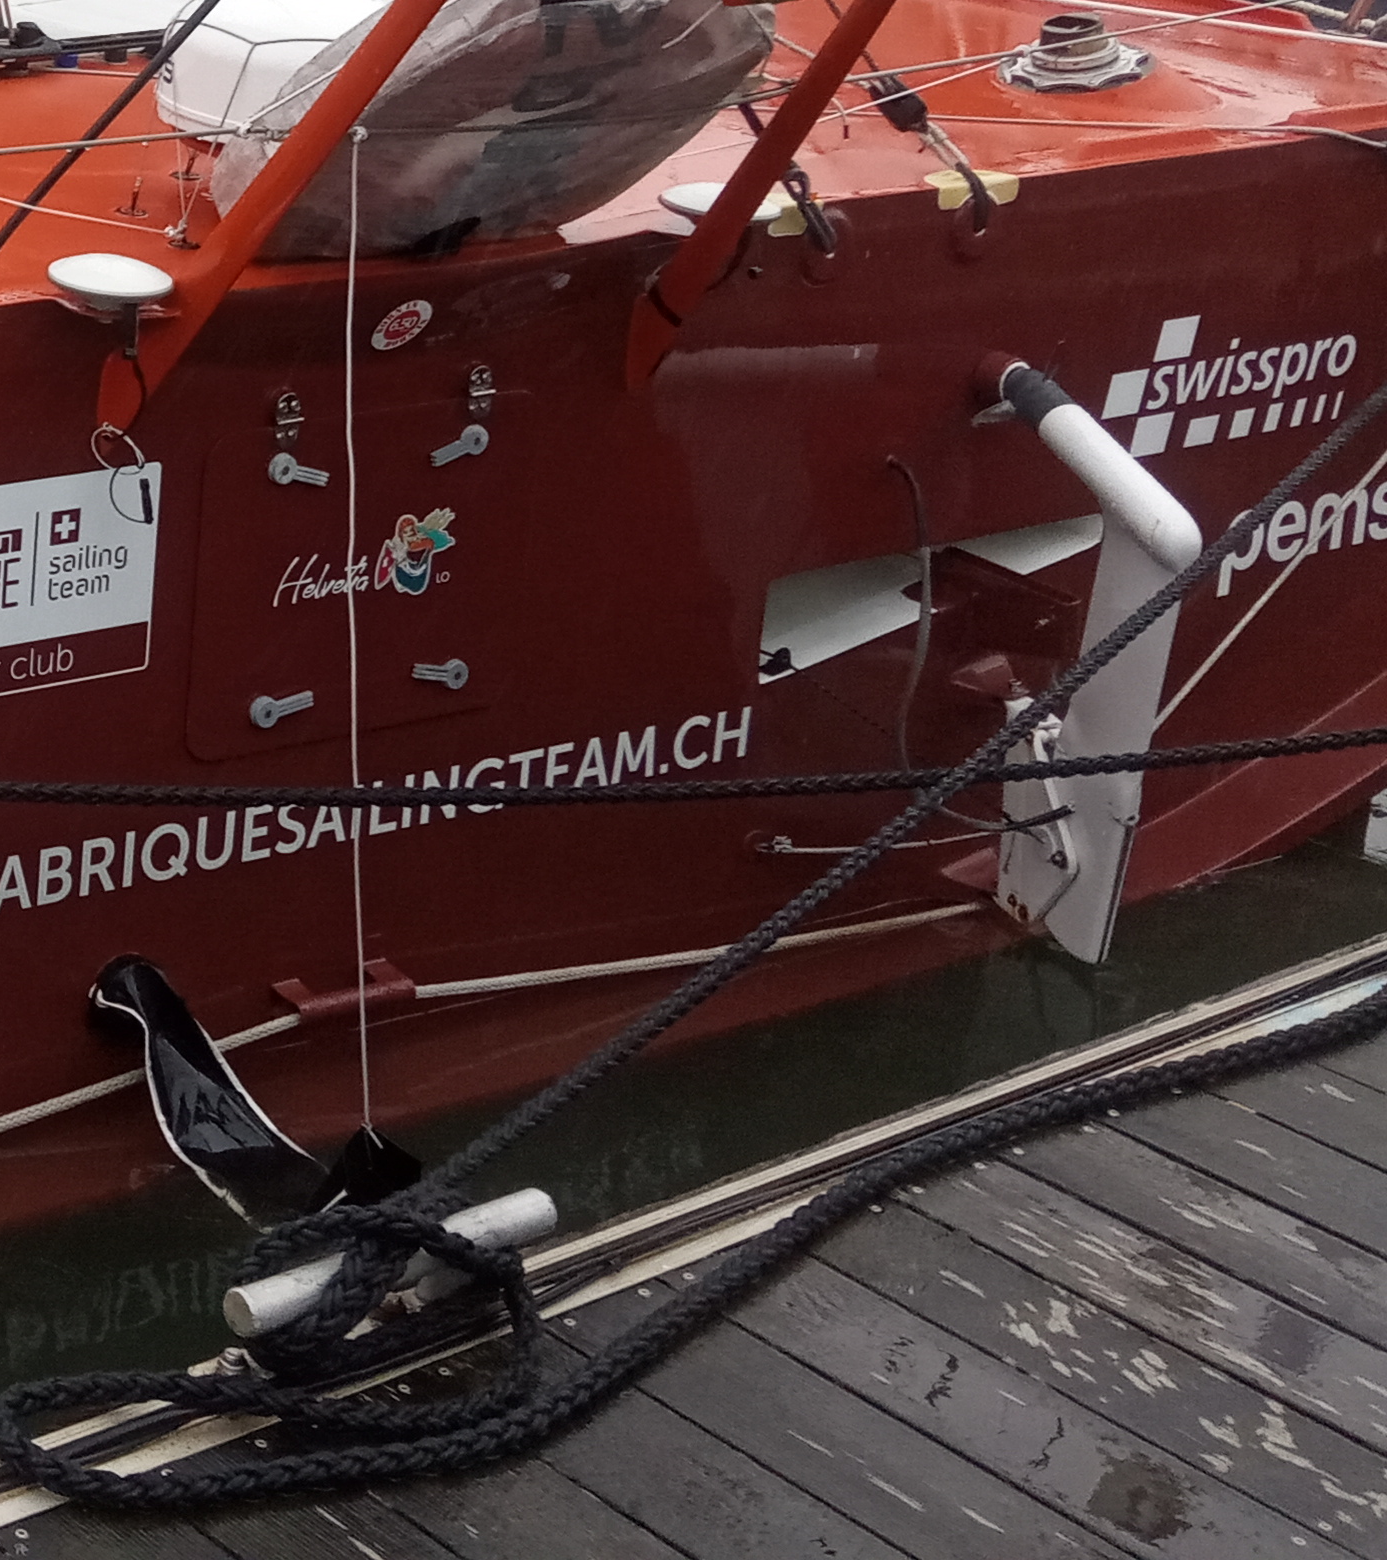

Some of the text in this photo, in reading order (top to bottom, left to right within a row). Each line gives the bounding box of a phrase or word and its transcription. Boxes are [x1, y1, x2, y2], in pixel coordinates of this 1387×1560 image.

[1146, 334, 1357, 410] swisspro
[49, 545, 128, 575] sailing
[48, 575, 111, 602] team
[10, 643, 75, 681] club
